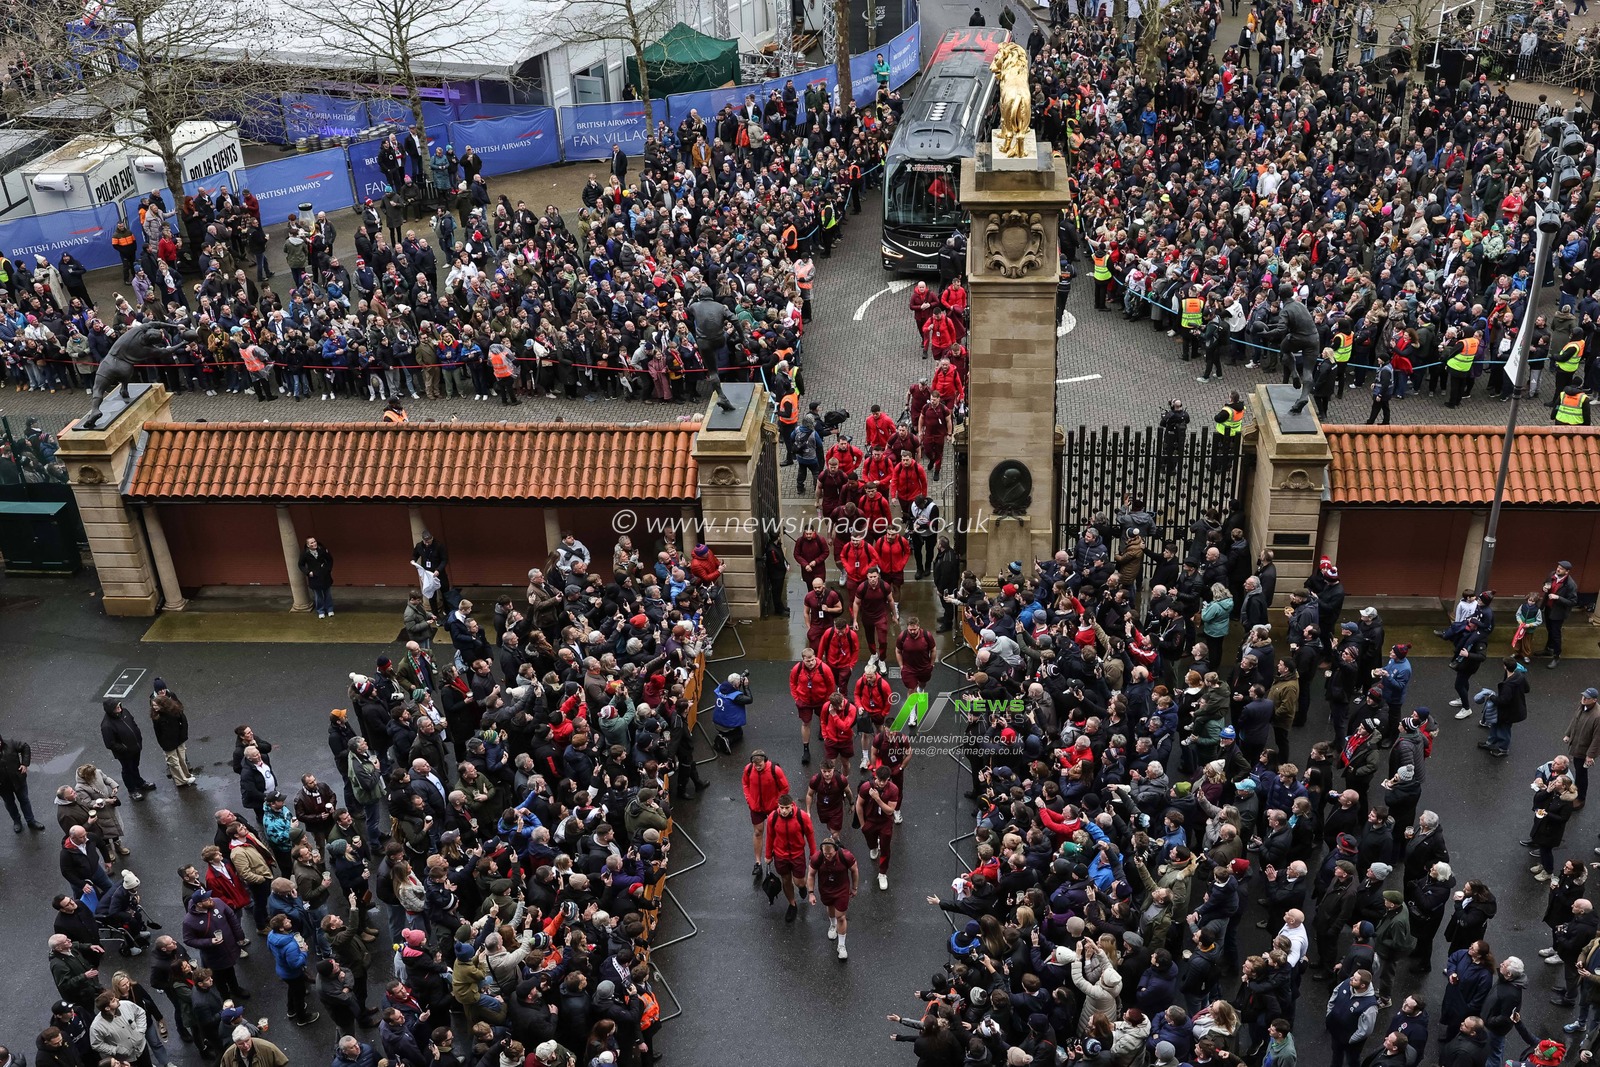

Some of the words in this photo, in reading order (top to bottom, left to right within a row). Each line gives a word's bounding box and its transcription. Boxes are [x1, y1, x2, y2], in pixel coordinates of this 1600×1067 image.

[576, 120, 606, 130] BRITISH
[607, 118, 638, 127] AIRWAYS
[471, 145, 500, 154] BRITISH
[502, 139, 531, 151] AIRWAYS
[573, 134, 599, 147] FAN
[212, 143, 238, 174] EVENTS
[95, 175, 118, 203] POLAR
[118, 165, 134, 190] EVE
[255, 186, 288, 201] BRITISH
[288, 180, 321, 195] AIRWAYS
[12, 243, 49, 256] BRITISH
[51, 236, 89, 249] AIRWAYS
[908, 240, 941, 248] EDWARD
